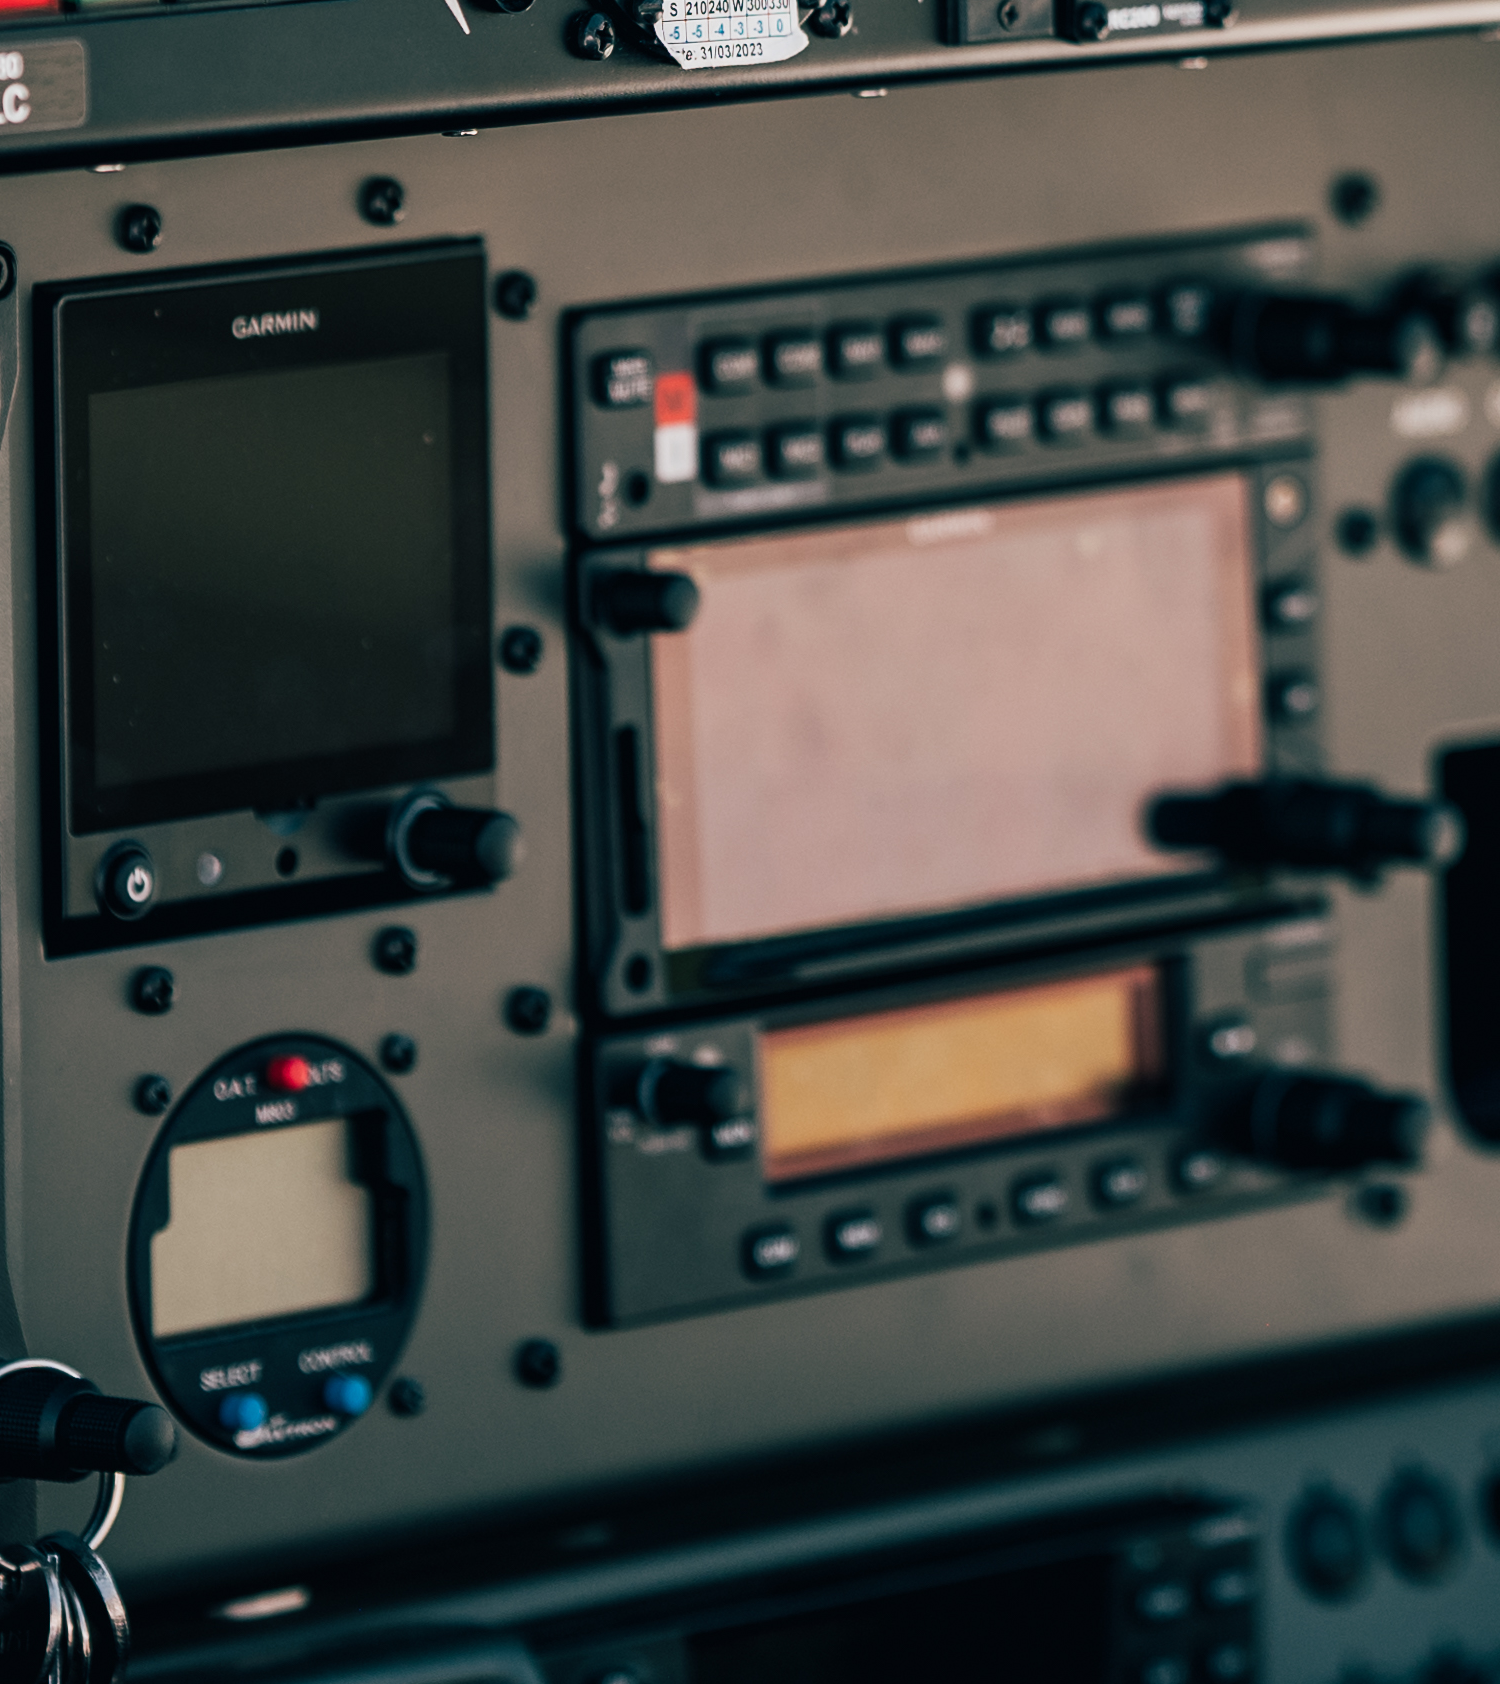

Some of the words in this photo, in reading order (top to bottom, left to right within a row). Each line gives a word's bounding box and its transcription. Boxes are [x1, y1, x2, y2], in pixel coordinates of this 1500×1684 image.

[669, 2, 678, 17] S
[686, 0, 707, 16] 210
[708, 0, 729, 14] 240
[669, 26, 680, 40] -5
[692, 24, 703, 38] -5
[714, 23, 725, 36] -4
[734, 21, 744, 35] -3
[753, 20, 764, 34] -3
[776, 18, 783, 33] 0
[700, 42, 764, 60] 31/03/2023
[231, 309, 318, 340] GARMIN
[298, 1340, 374, 1375] CONTROL
[199, 1359, 263, 1393] SELECT
